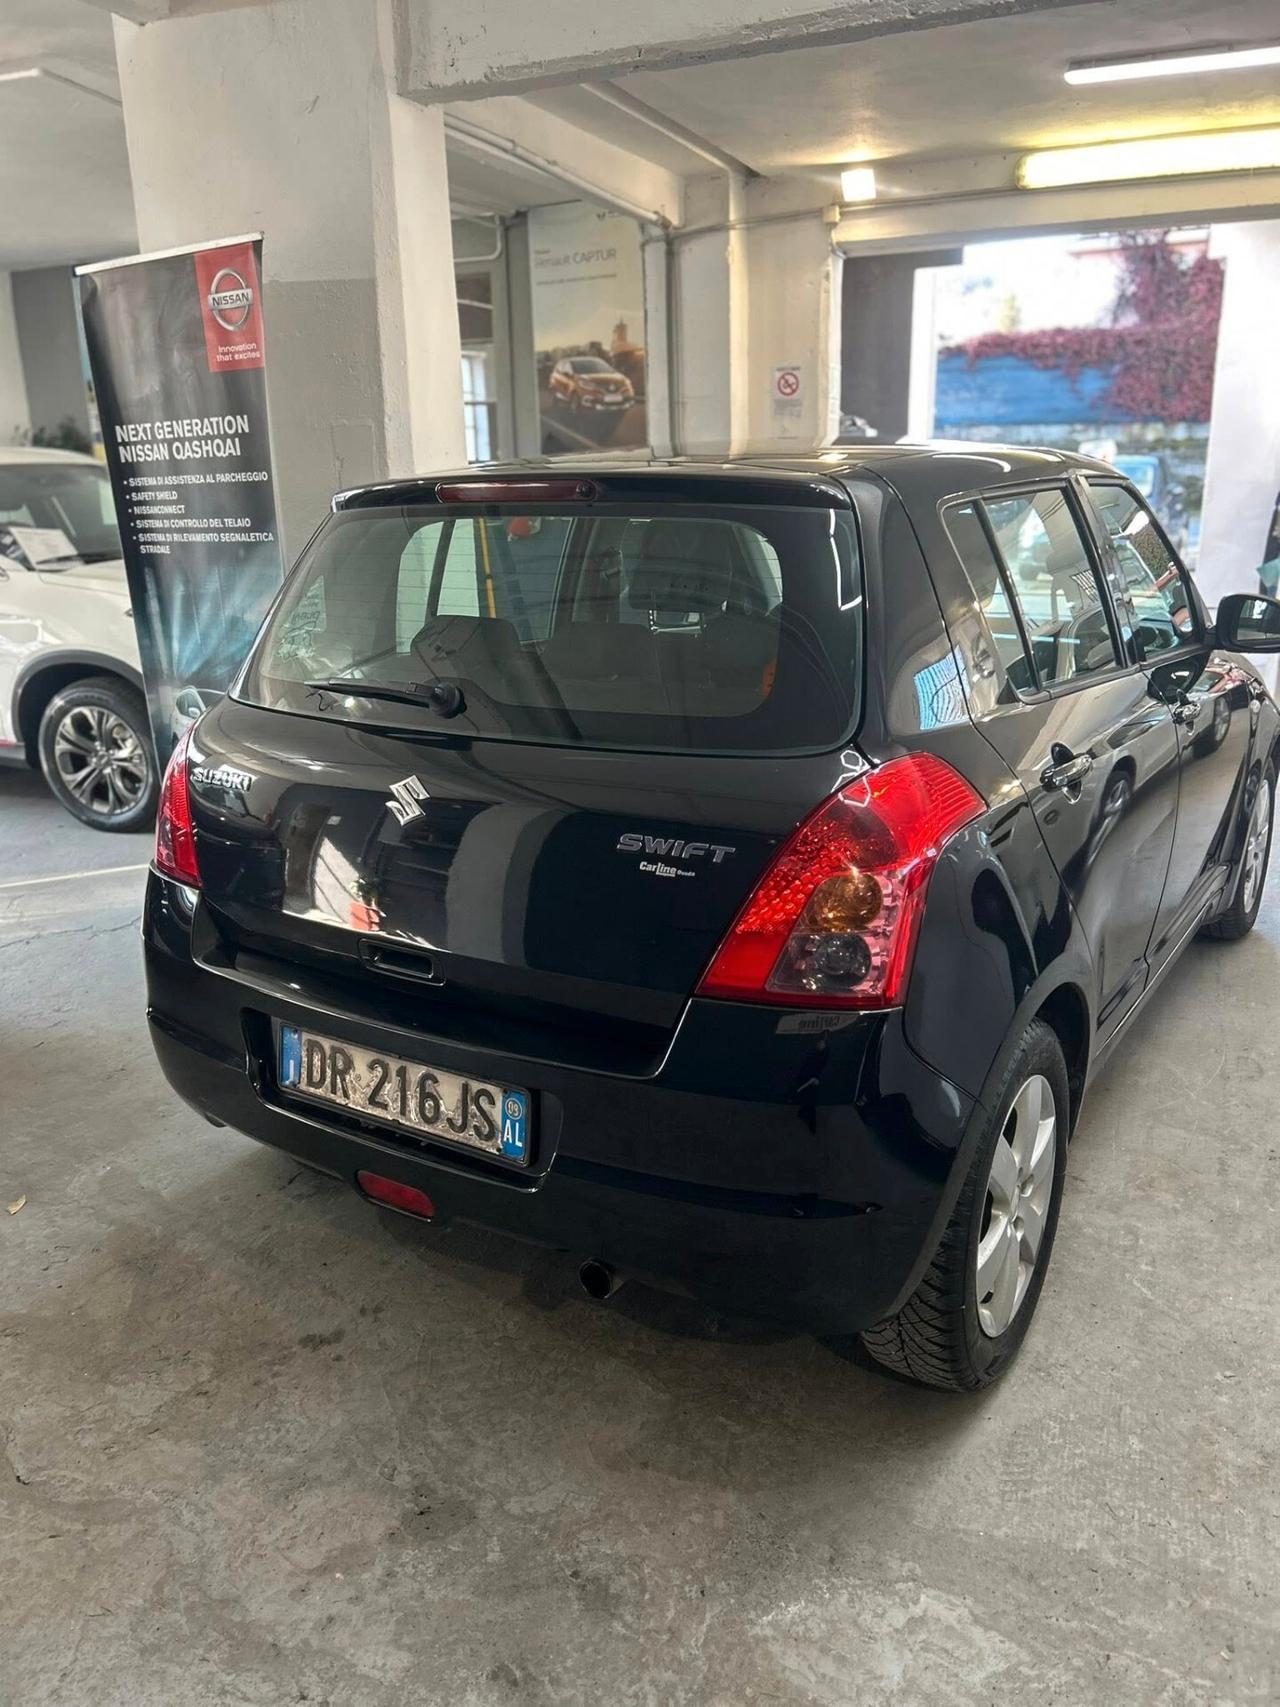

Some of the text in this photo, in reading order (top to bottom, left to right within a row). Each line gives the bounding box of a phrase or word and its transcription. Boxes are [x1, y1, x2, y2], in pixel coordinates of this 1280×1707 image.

[573, 248, 617, 265] CAPTUR
[212, 292, 250, 307] NISSAN
[218, 343, 257, 353] Innovation
[216, 351, 260, 362] that excites
[115, 414, 250, 443] NEXT GENERATION
[119, 437, 241, 463] NISSAN QASHQAI
[128, 471, 269, 487] SISTEMA DI ASSISTENZA AL PARCHEGGIO
[131, 490, 178, 501] SAFETY SHIELD
[133, 504, 185, 515] NISSANCONNECT
[136, 519, 163, 529] SISTEMA
[170, 518, 209, 528] CONTROLLO
[209, 518, 223, 528] DEL
[223, 517, 252, 528] TELAIO
[138, 532, 166, 542] SISTEMA
[173, 532, 219, 542] RILEVAMENTO
[219, 532, 274, 542] SEGNALETICA
[140, 545, 171, 554] STRADALE
[190, 766, 253, 793] SUZUKI
[616, 833, 736, 863] SWIFT
[305, 1038, 355, 1101] DR
[503, 1119, 523, 1148] AL
